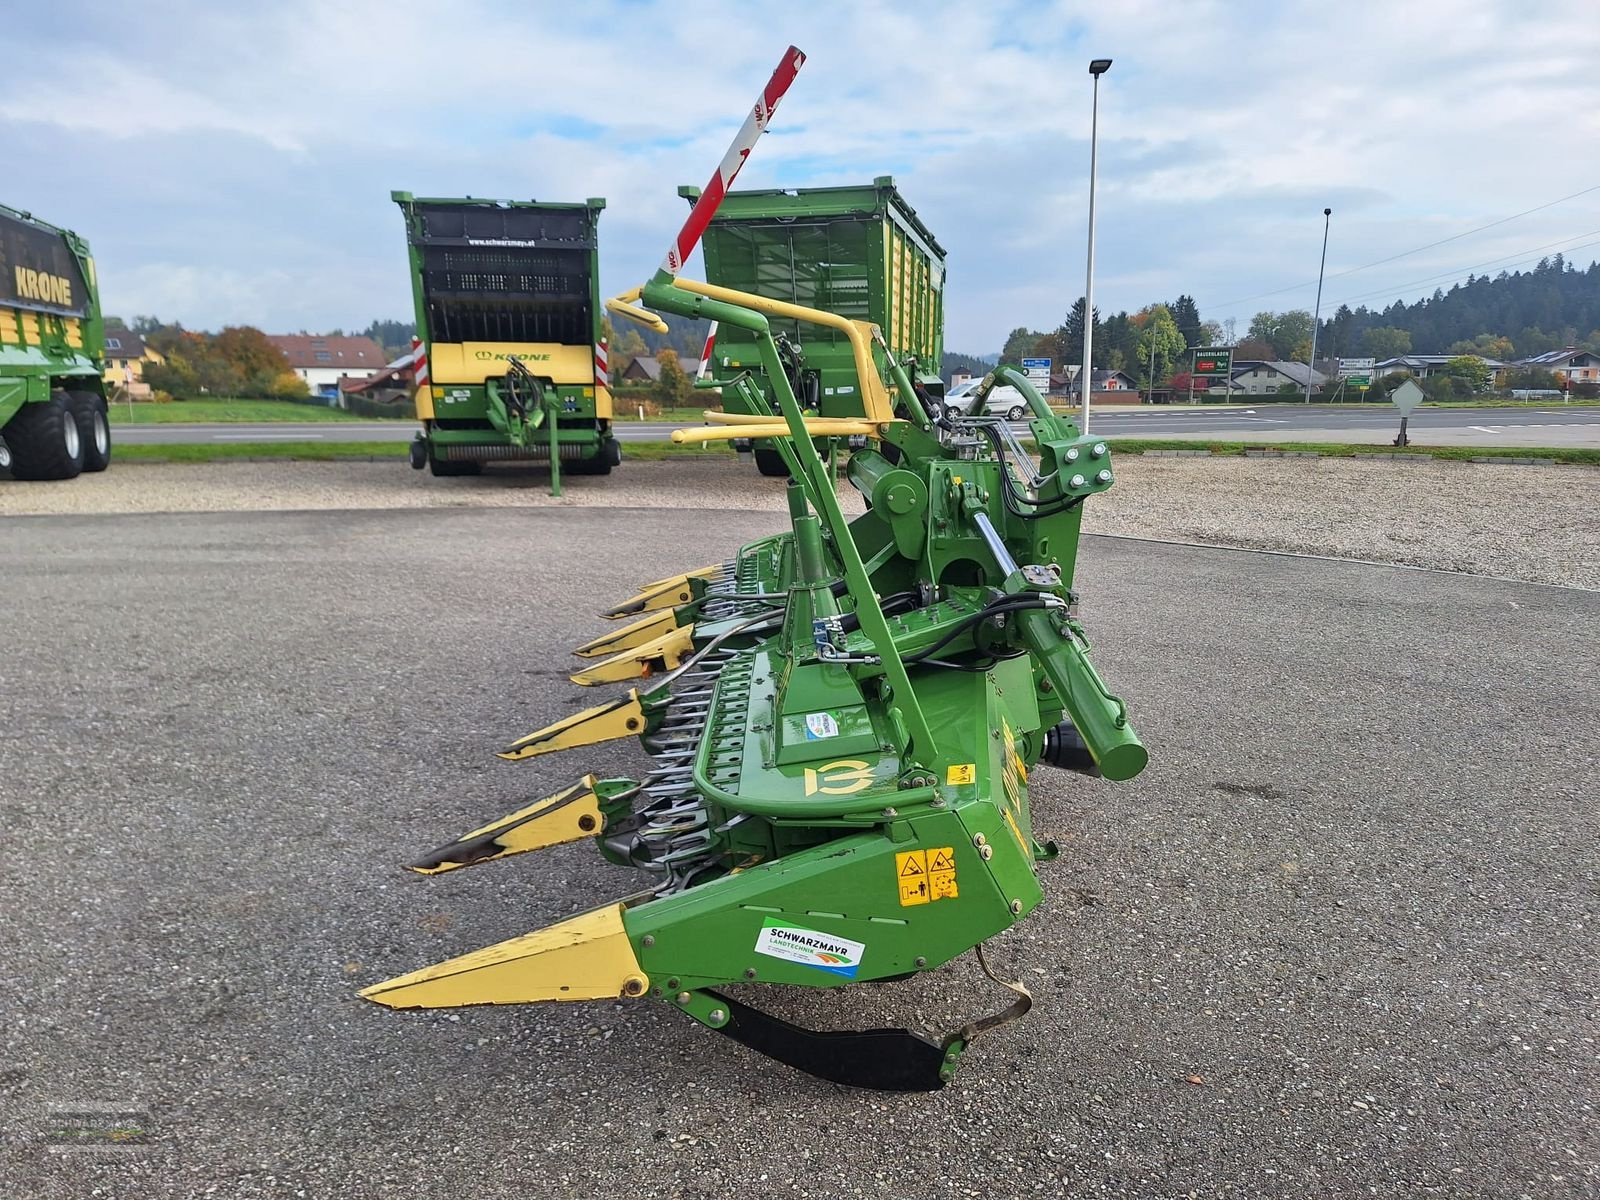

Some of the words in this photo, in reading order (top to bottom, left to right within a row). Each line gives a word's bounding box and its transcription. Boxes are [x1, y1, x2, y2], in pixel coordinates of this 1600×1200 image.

[14, 265, 72, 306] KRONE
[769, 938, 814, 954] LANDTECHNIK
[770, 928, 848, 956] SCHWARZMAYR
